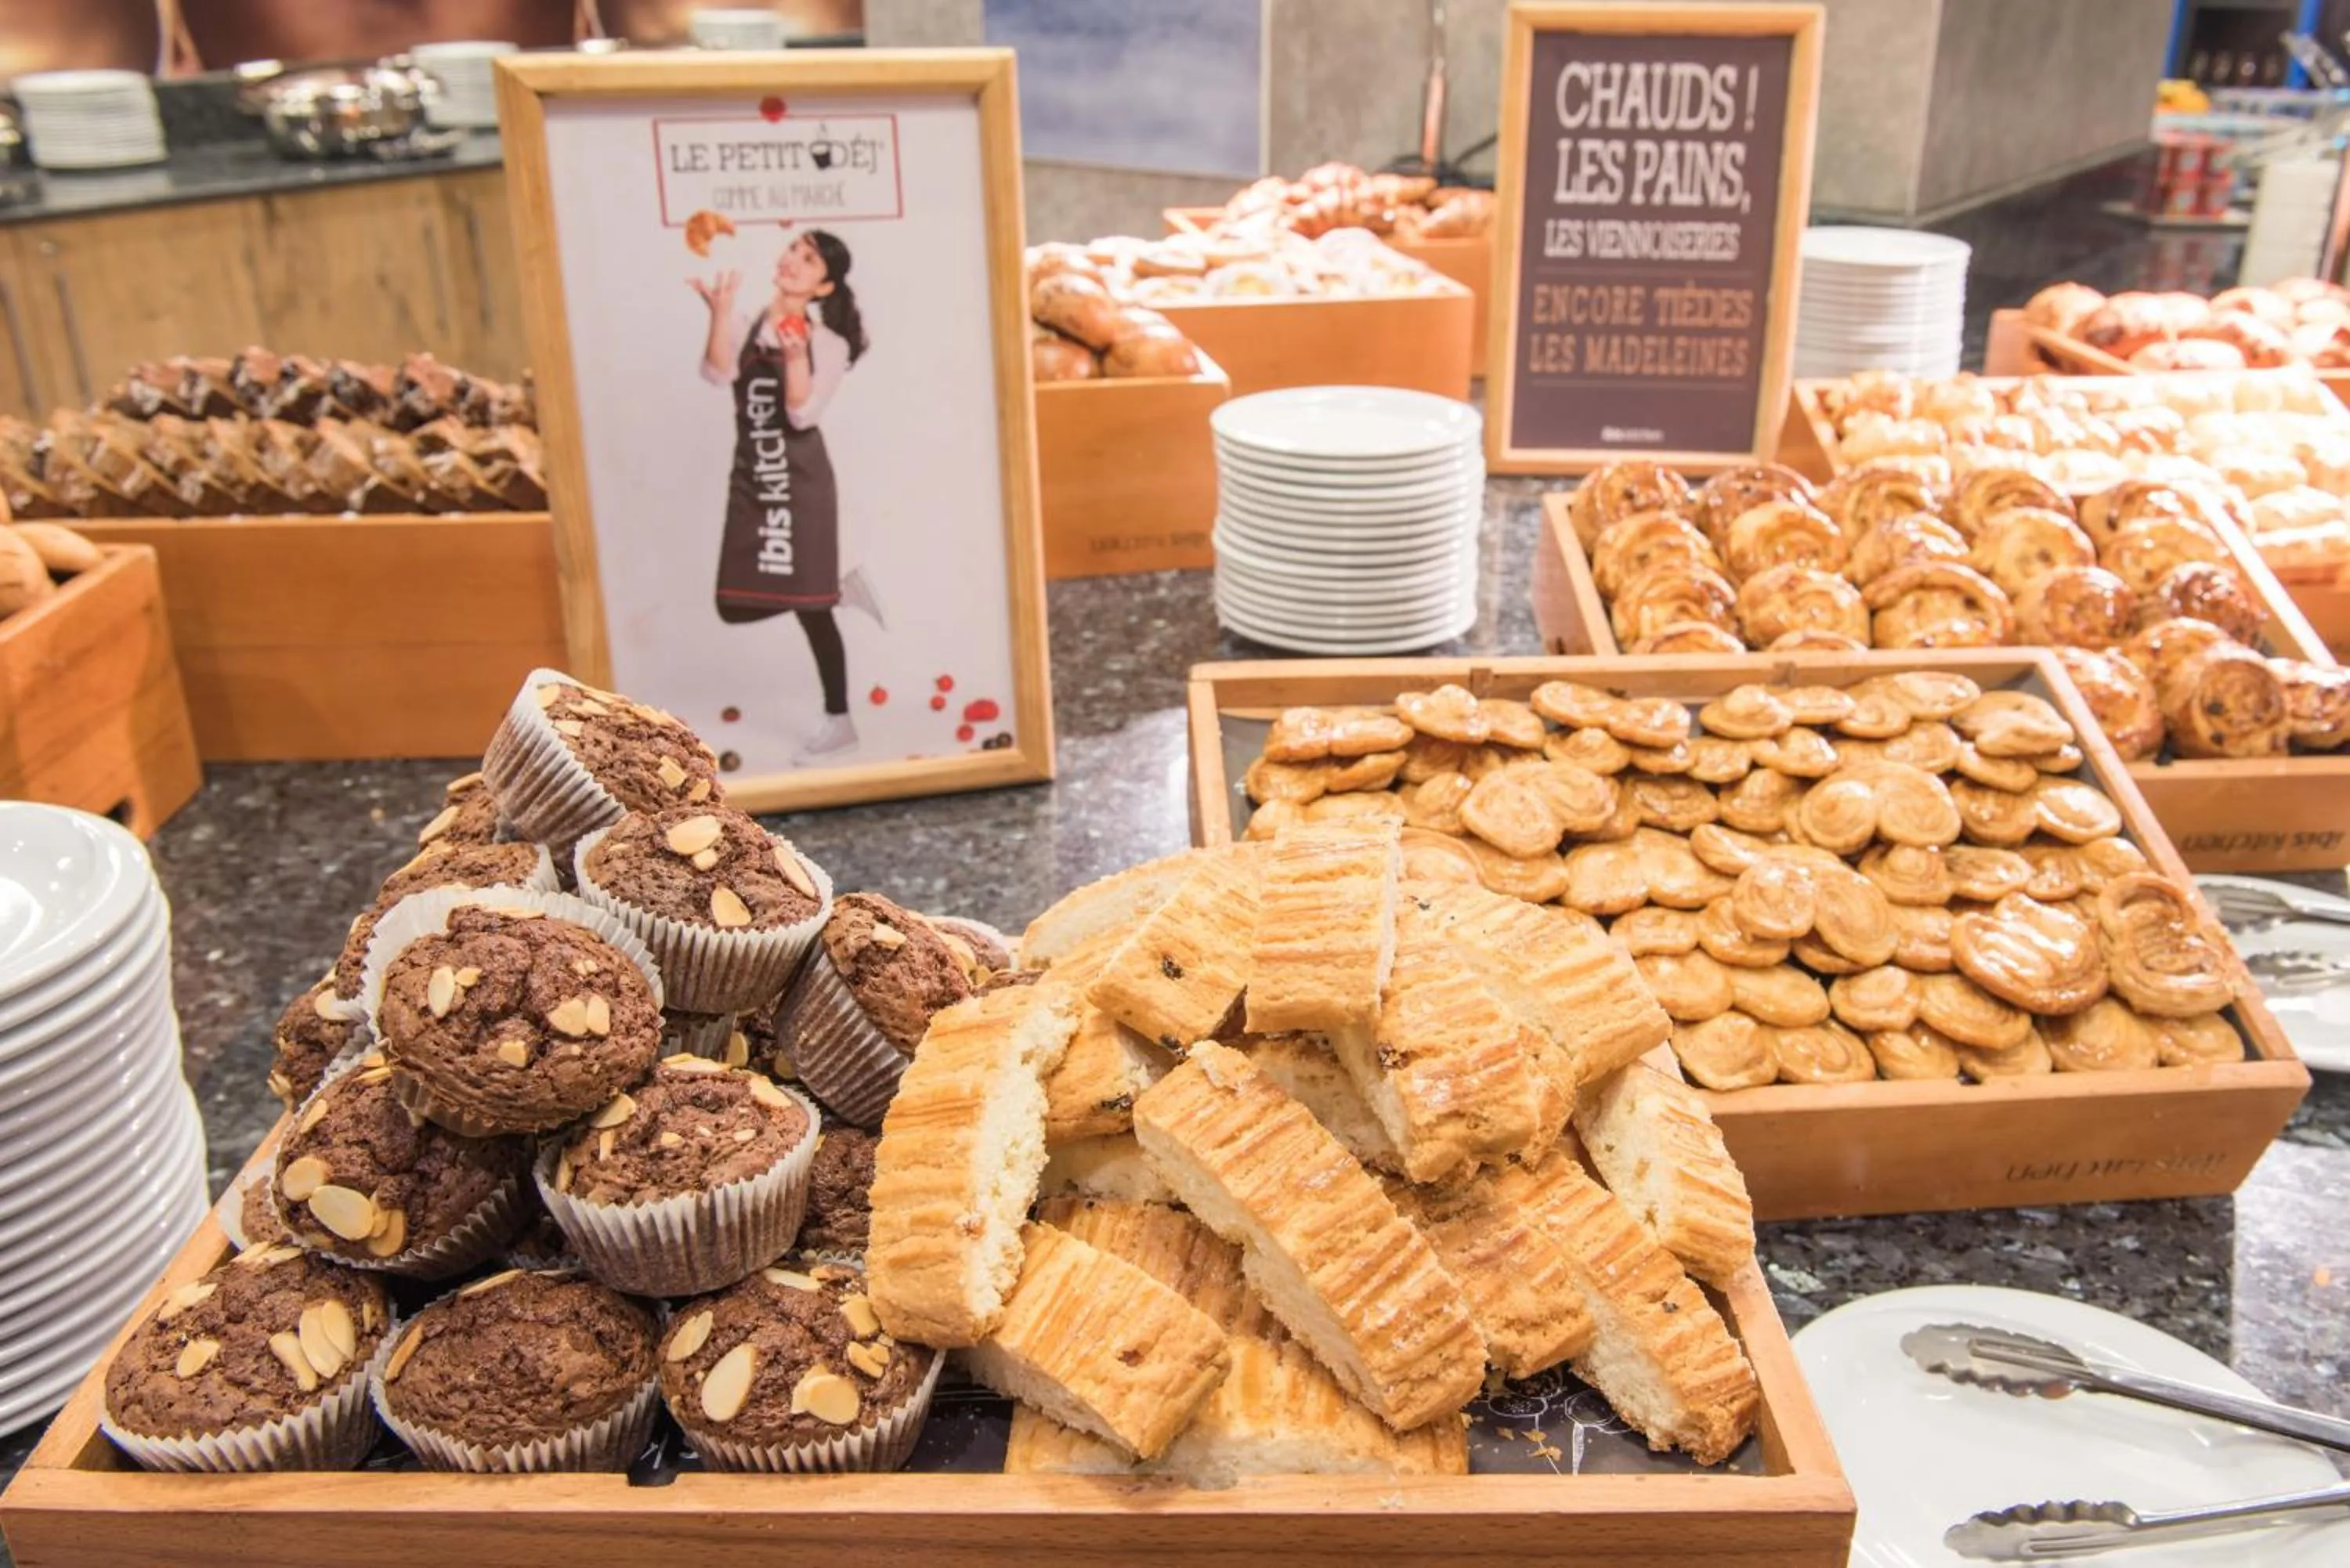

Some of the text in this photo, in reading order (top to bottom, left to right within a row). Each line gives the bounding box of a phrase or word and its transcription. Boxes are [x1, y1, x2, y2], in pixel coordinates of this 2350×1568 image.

[1556, 61, 1737, 131] CHAUDS
[671, 143, 708, 172] LE
[718, 141, 803, 171] PETIT
[1554, 138, 1752, 215] LES PAINS,
[1544, 219, 1584, 258] LES
[1531, 278, 1754, 327] ENCORE TIÈDES
[1528, 333, 1749, 377] LES MADELEINES
[757, 508, 794, 575] ibis
